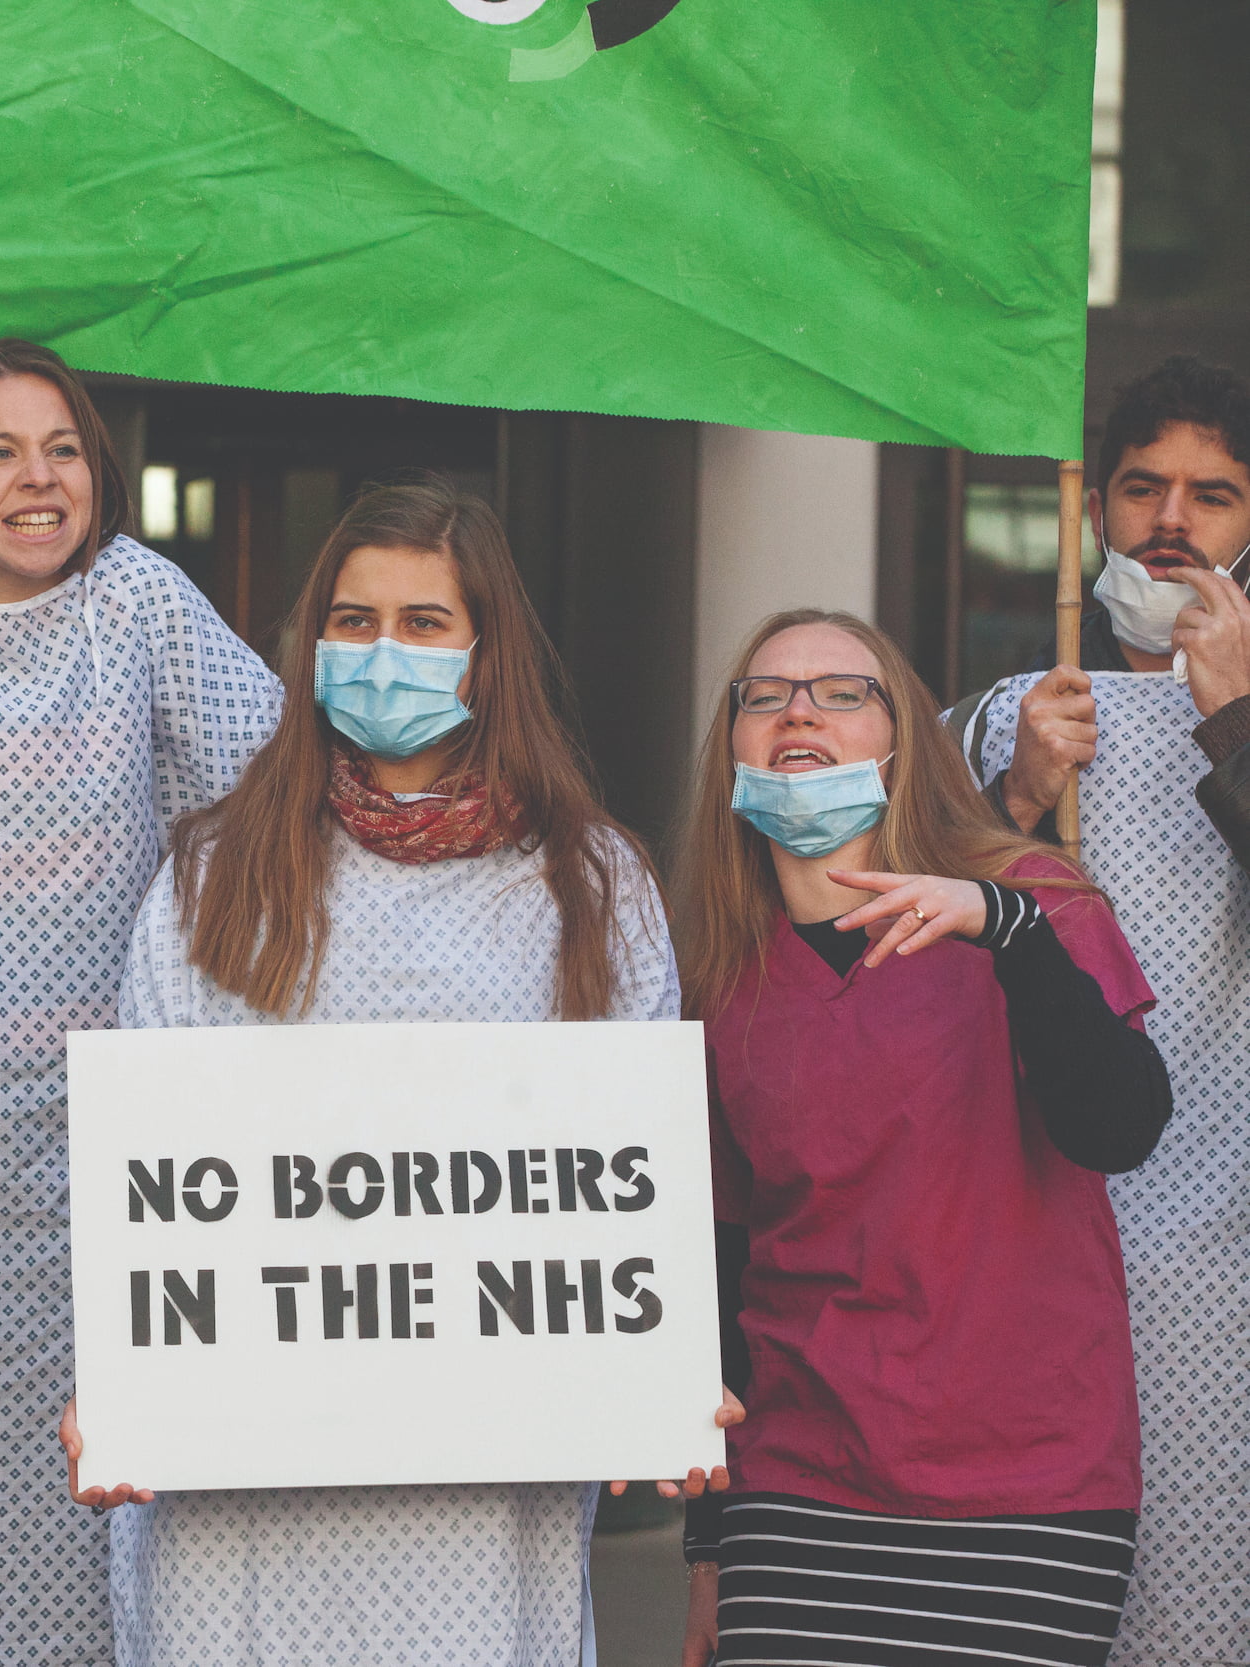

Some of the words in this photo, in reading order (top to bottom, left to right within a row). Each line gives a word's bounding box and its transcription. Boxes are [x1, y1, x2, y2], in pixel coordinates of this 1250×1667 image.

[129, 1157, 238, 1222] NO
[273, 1147, 654, 1219] BORDERS
[131, 1270, 216, 1346] IN
[262, 1263, 434, 1341] THE
[478, 1258, 662, 1336] NHS
